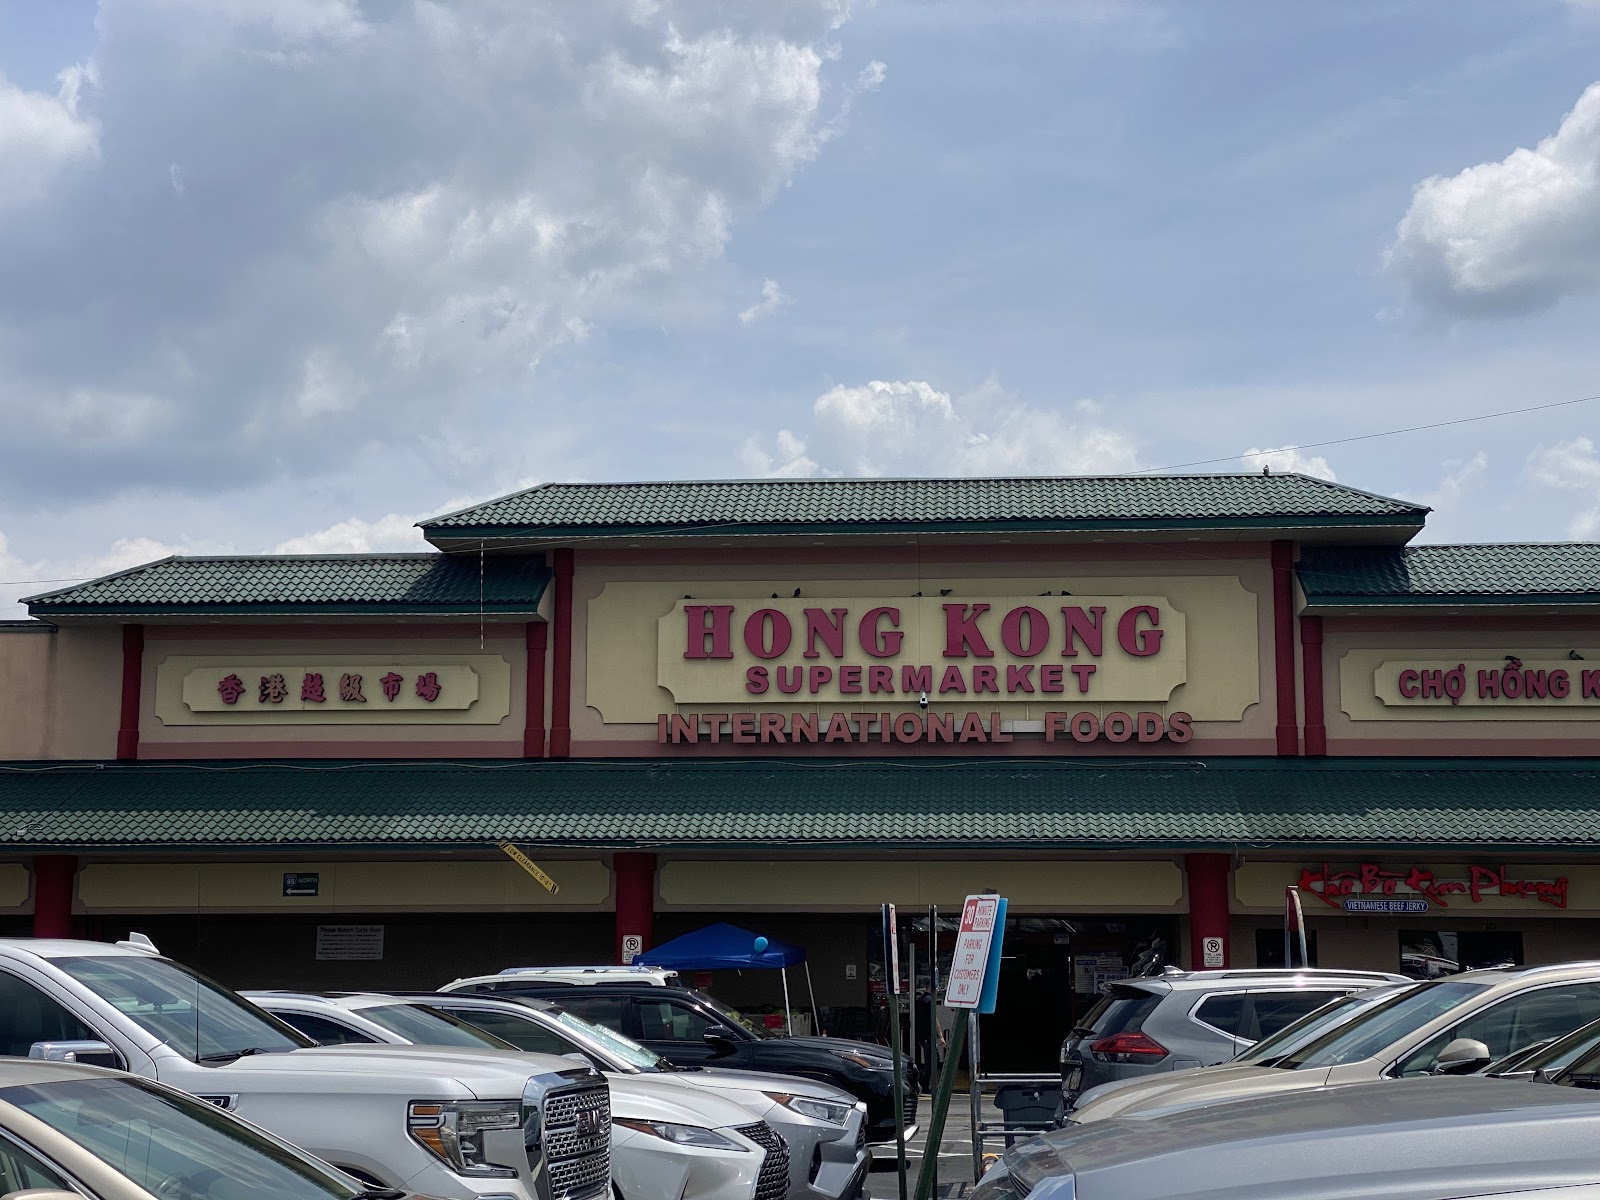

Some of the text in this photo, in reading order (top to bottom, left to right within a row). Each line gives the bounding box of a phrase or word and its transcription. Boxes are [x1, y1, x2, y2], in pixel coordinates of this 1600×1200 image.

[683, 603, 1164, 660] HONG KONG
[217, 672, 443, 704] 香港超級市場
[745, 664, 1097, 694] SUPERMARKET
[1399, 663, 1466, 705] CHỢ
[657, 711, 1194, 745] INTERNATIONAL FOODS
[507, 846, 517, 856] LOW
[516, 854, 540, 877] CLEARANCE
[965, 905, 975, 925] 30
[1347, 901, 1425, 911] VIETNAMESE BEEF JERKY
[974, 917, 991, 929] PARKING
[963, 938, 983, 950] PARKING
[964, 954, 974, 965] FOR
[954, 969, 980, 981] CUSTOMERS
[957, 984, 970, 995] ONLY
